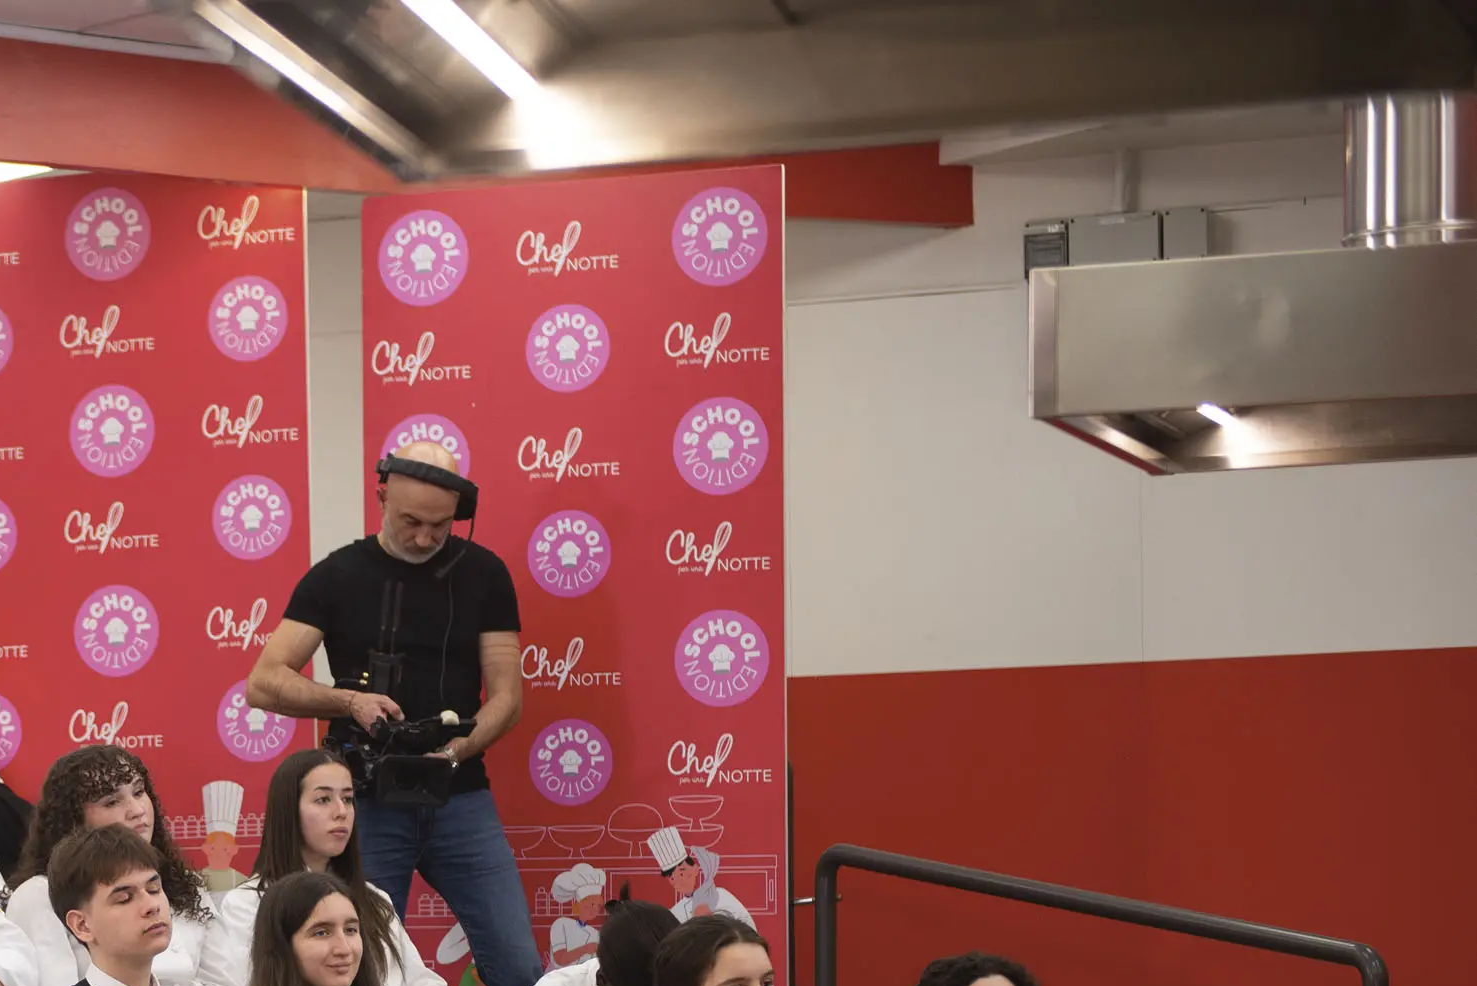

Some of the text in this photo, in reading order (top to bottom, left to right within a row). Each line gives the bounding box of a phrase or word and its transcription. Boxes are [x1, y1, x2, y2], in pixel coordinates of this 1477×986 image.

[74, 196, 142, 272] SCHOOL EDITION
[197, 195, 295, 249] Chef NOTTE
[516, 221, 619, 277] Chef NOTTE
[682, 196, 758, 277] SCHOOL EDITION
[388, 219, 460, 297] SCHOOL EDITION
[60, 305, 154, 358] Chef NOTTE
[216, 284, 280, 353] SCHOOL EDITION
[664, 312, 770, 368] Chef NOTTE
[372, 332, 471, 386] Chef NOTTE
[534, 312, 602, 384] SCHOOL EDITION
[78, 393, 147, 468] SCHOOL EDITION
[202, 395, 299, 448] Chef NOTTE
[390, 422, 462, 460] CHOO
[683, 406, 759, 485] SCHOOL EDITION
[518, 427, 582, 482] Chef
[568, 462, 620, 477] NOTTE
[64, 502, 159, 554] Chef NOTTE
[220, 483, 284, 552] SCHOOL EDITION
[536, 518, 603, 589] SCHOOL EDITION
[666, 521, 732, 576] Chef
[717, 556, 772, 571] NOTTE
[82, 594, 151, 668] SCHOOL EDITION
[206, 598, 267, 651] Chef
[521, 637, 584, 691] Chef
[570, 672, 621, 686] NOTTE
[684, 619, 760, 697] SCHOOL EDITION
[69, 701, 163, 749] Chef NOTTE
[225, 721, 286, 754] EDITION
[538, 727, 604, 798] SCHOOL EDITION
[668, 733, 733, 787] Chef
[719, 768, 772, 783] NOTTE
